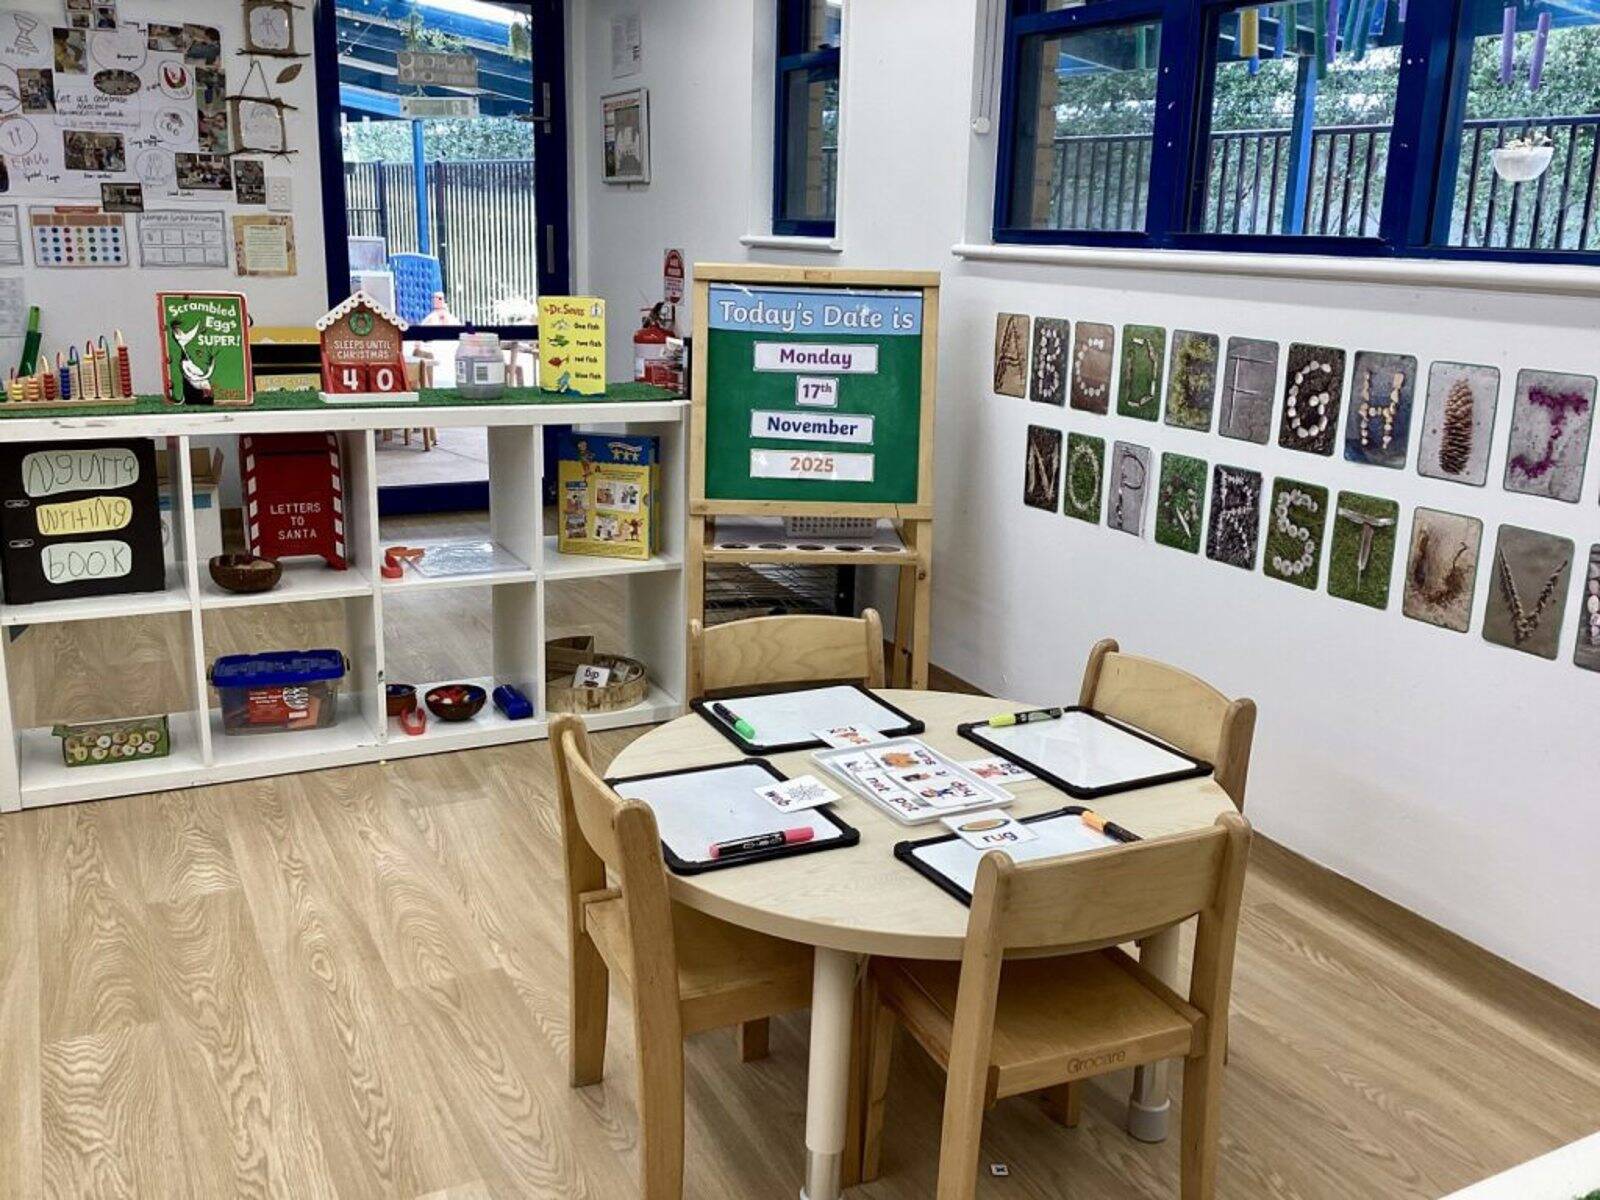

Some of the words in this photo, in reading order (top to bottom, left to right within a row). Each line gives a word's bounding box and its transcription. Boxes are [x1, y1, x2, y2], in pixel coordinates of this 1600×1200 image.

[168, 301, 237, 317] Scrambled
[719, 301, 814, 332] Today's
[824, 304, 882, 329] Date
[893, 307, 914, 329] is
[205, 316, 237, 333] Eggs
[197, 334, 240, 347] SUPER!
[334, 340, 365, 349] SLEEPS
[366, 340, 391, 349] UNTIL
[337, 349, 390, 359] CHRISTMAS
[779, 348, 853, 369] Monday
[802, 382, 832, 400] 17th
[767, 416, 858, 436] November
[790, 456, 834, 473] 2025
[269, 502, 321, 515] LETTERS
[290, 516, 305, 526] TO
[277, 528, 317, 540] SANTA
[982, 830, 1019, 844] rug
